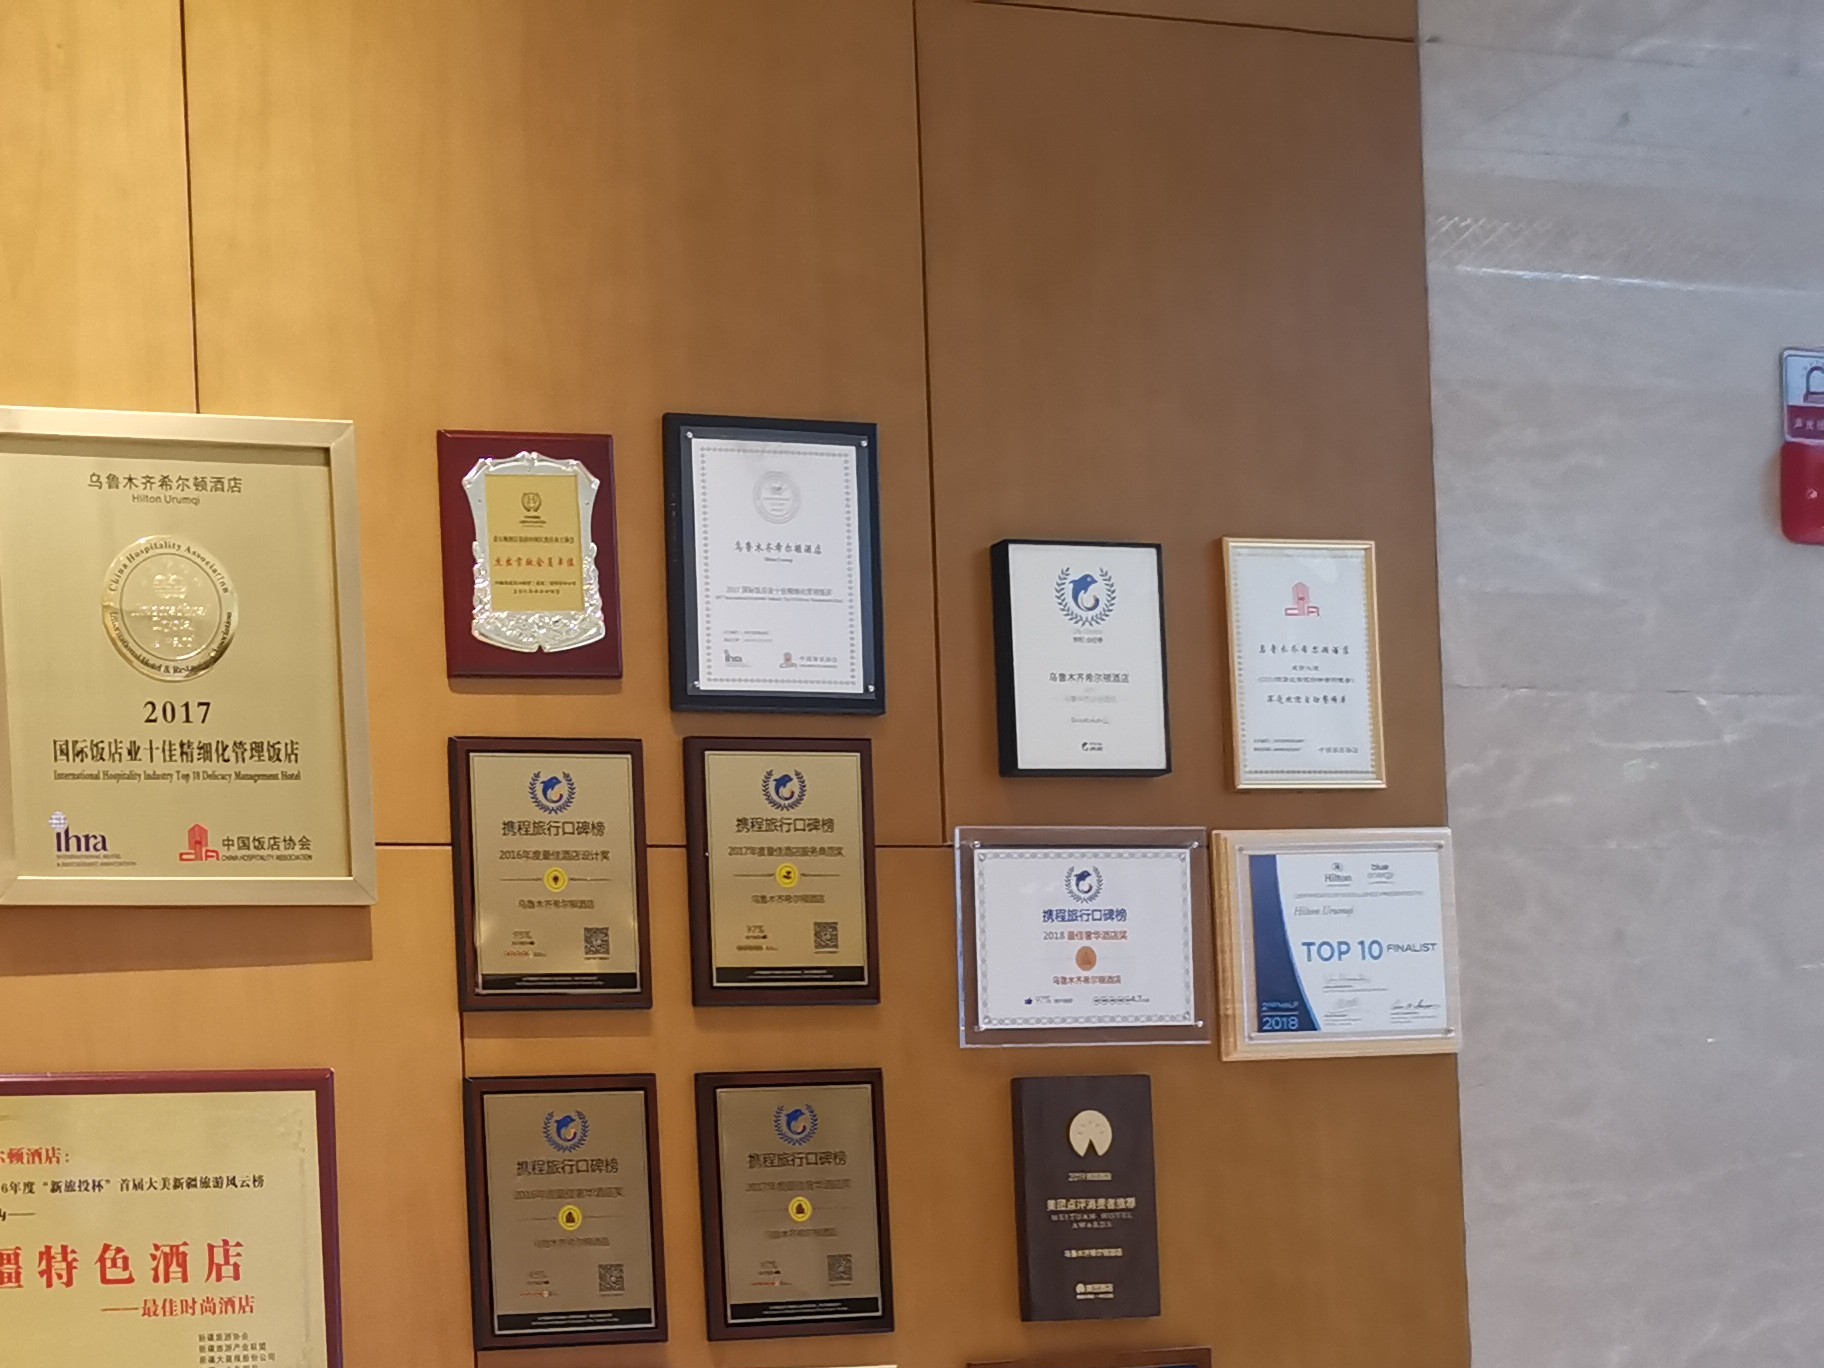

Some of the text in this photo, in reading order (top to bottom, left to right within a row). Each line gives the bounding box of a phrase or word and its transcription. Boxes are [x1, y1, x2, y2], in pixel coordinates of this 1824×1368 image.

[87, 472, 243, 493] 乌鲁木齐希尔顿酒店
[132, 494, 201, 506] Hilton Urumqi
[108, 563, 128, 592] China
[125, 541, 182, 564] Hospitality
[1048, 671, 1129, 684] 乌鲁木齐希尔顿酒店
[143, 701, 212, 725] 2017
[52, 738, 301, 765] 国际饭店业十佳精细化管理饭店
[53, 770, 101, 781] International
[102, 770, 142, 783] Hospitality
[143, 770, 174, 783] Industry
[176, 771, 191, 783] Top
[202, 770, 232, 782] Delicacy
[234, 771, 280, 783] Management
[281, 770, 301, 781] Hotel
[501, 820, 606, 838] 携程旅行口碑榜
[735, 817, 835, 834] 携程旅行口碑榜
[54, 825, 109, 853] ihra
[222, 835, 313, 853] 中国饭店协会
[1324, 873, 1353, 883] Hilton
[1042, 908, 1128, 923] 携程旅行口碑榜
[1042, 931, 1065, 941] 2018
[1301, 940, 1438, 963] TOP 10 FINALIST
[1261, 1016, 1299, 1031] 2018
[516, 1158, 619, 1176] 携程旅行口碑榜
[747, 1150, 848, 1169] 携程旅行口碑榜
